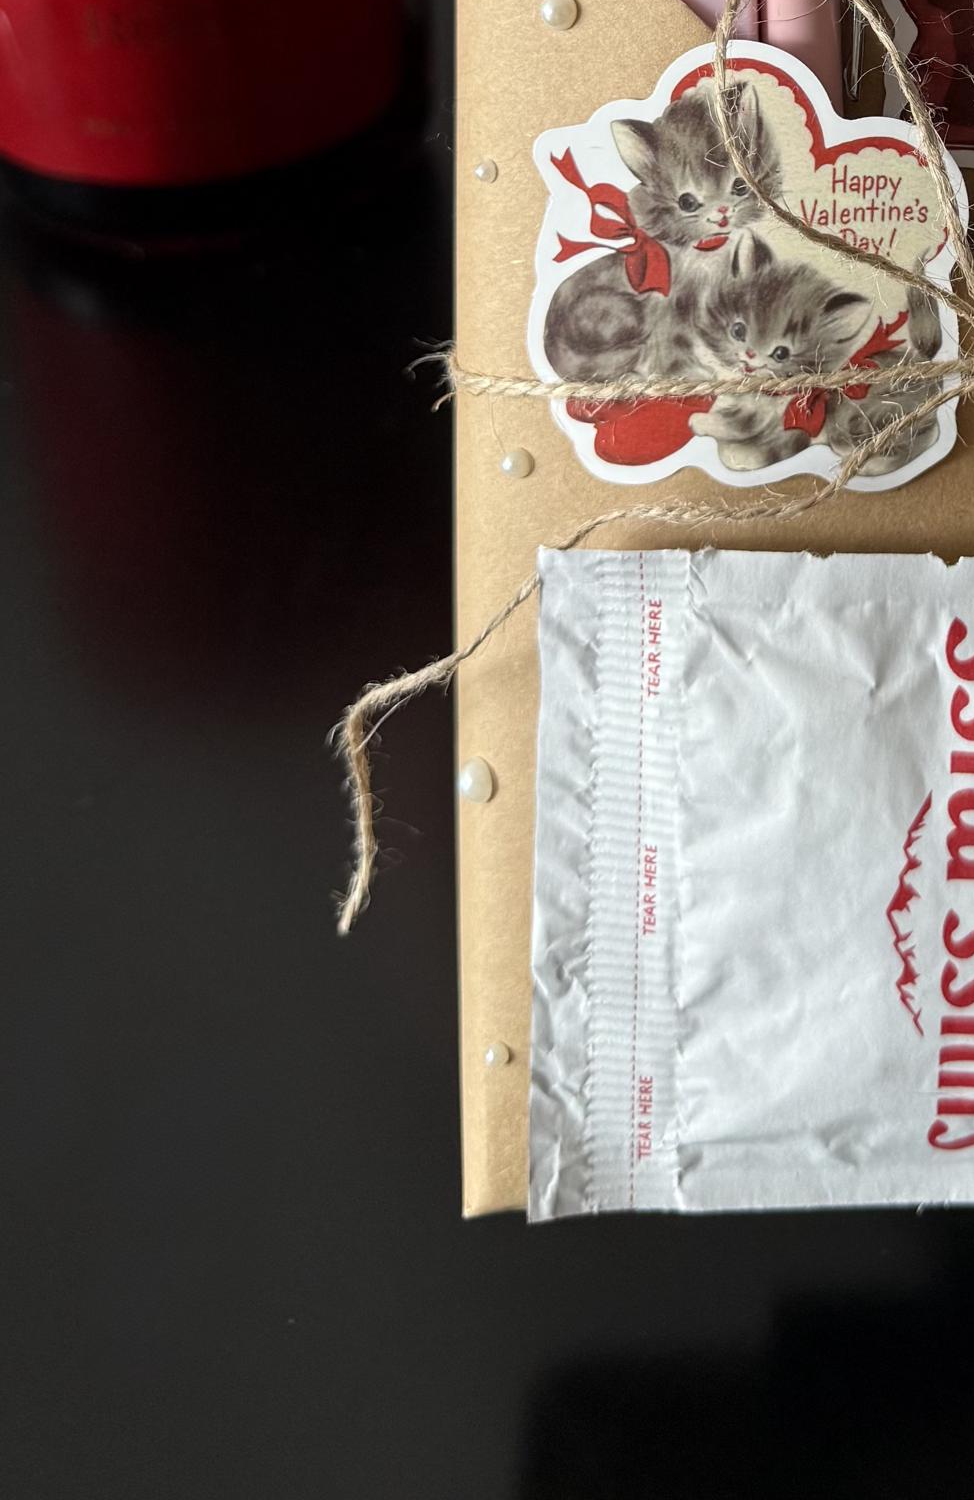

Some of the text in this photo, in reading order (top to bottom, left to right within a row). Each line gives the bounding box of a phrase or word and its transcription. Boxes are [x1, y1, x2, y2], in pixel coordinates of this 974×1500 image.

[800, 198, 929, 228] Valentine's
[831, 164, 902, 200] Happy
[647, 598, 663, 697] TEAR HERE
[642, 843, 658, 936] TEAR HERE
[637, 1075, 654, 1161] TEAR HERE
